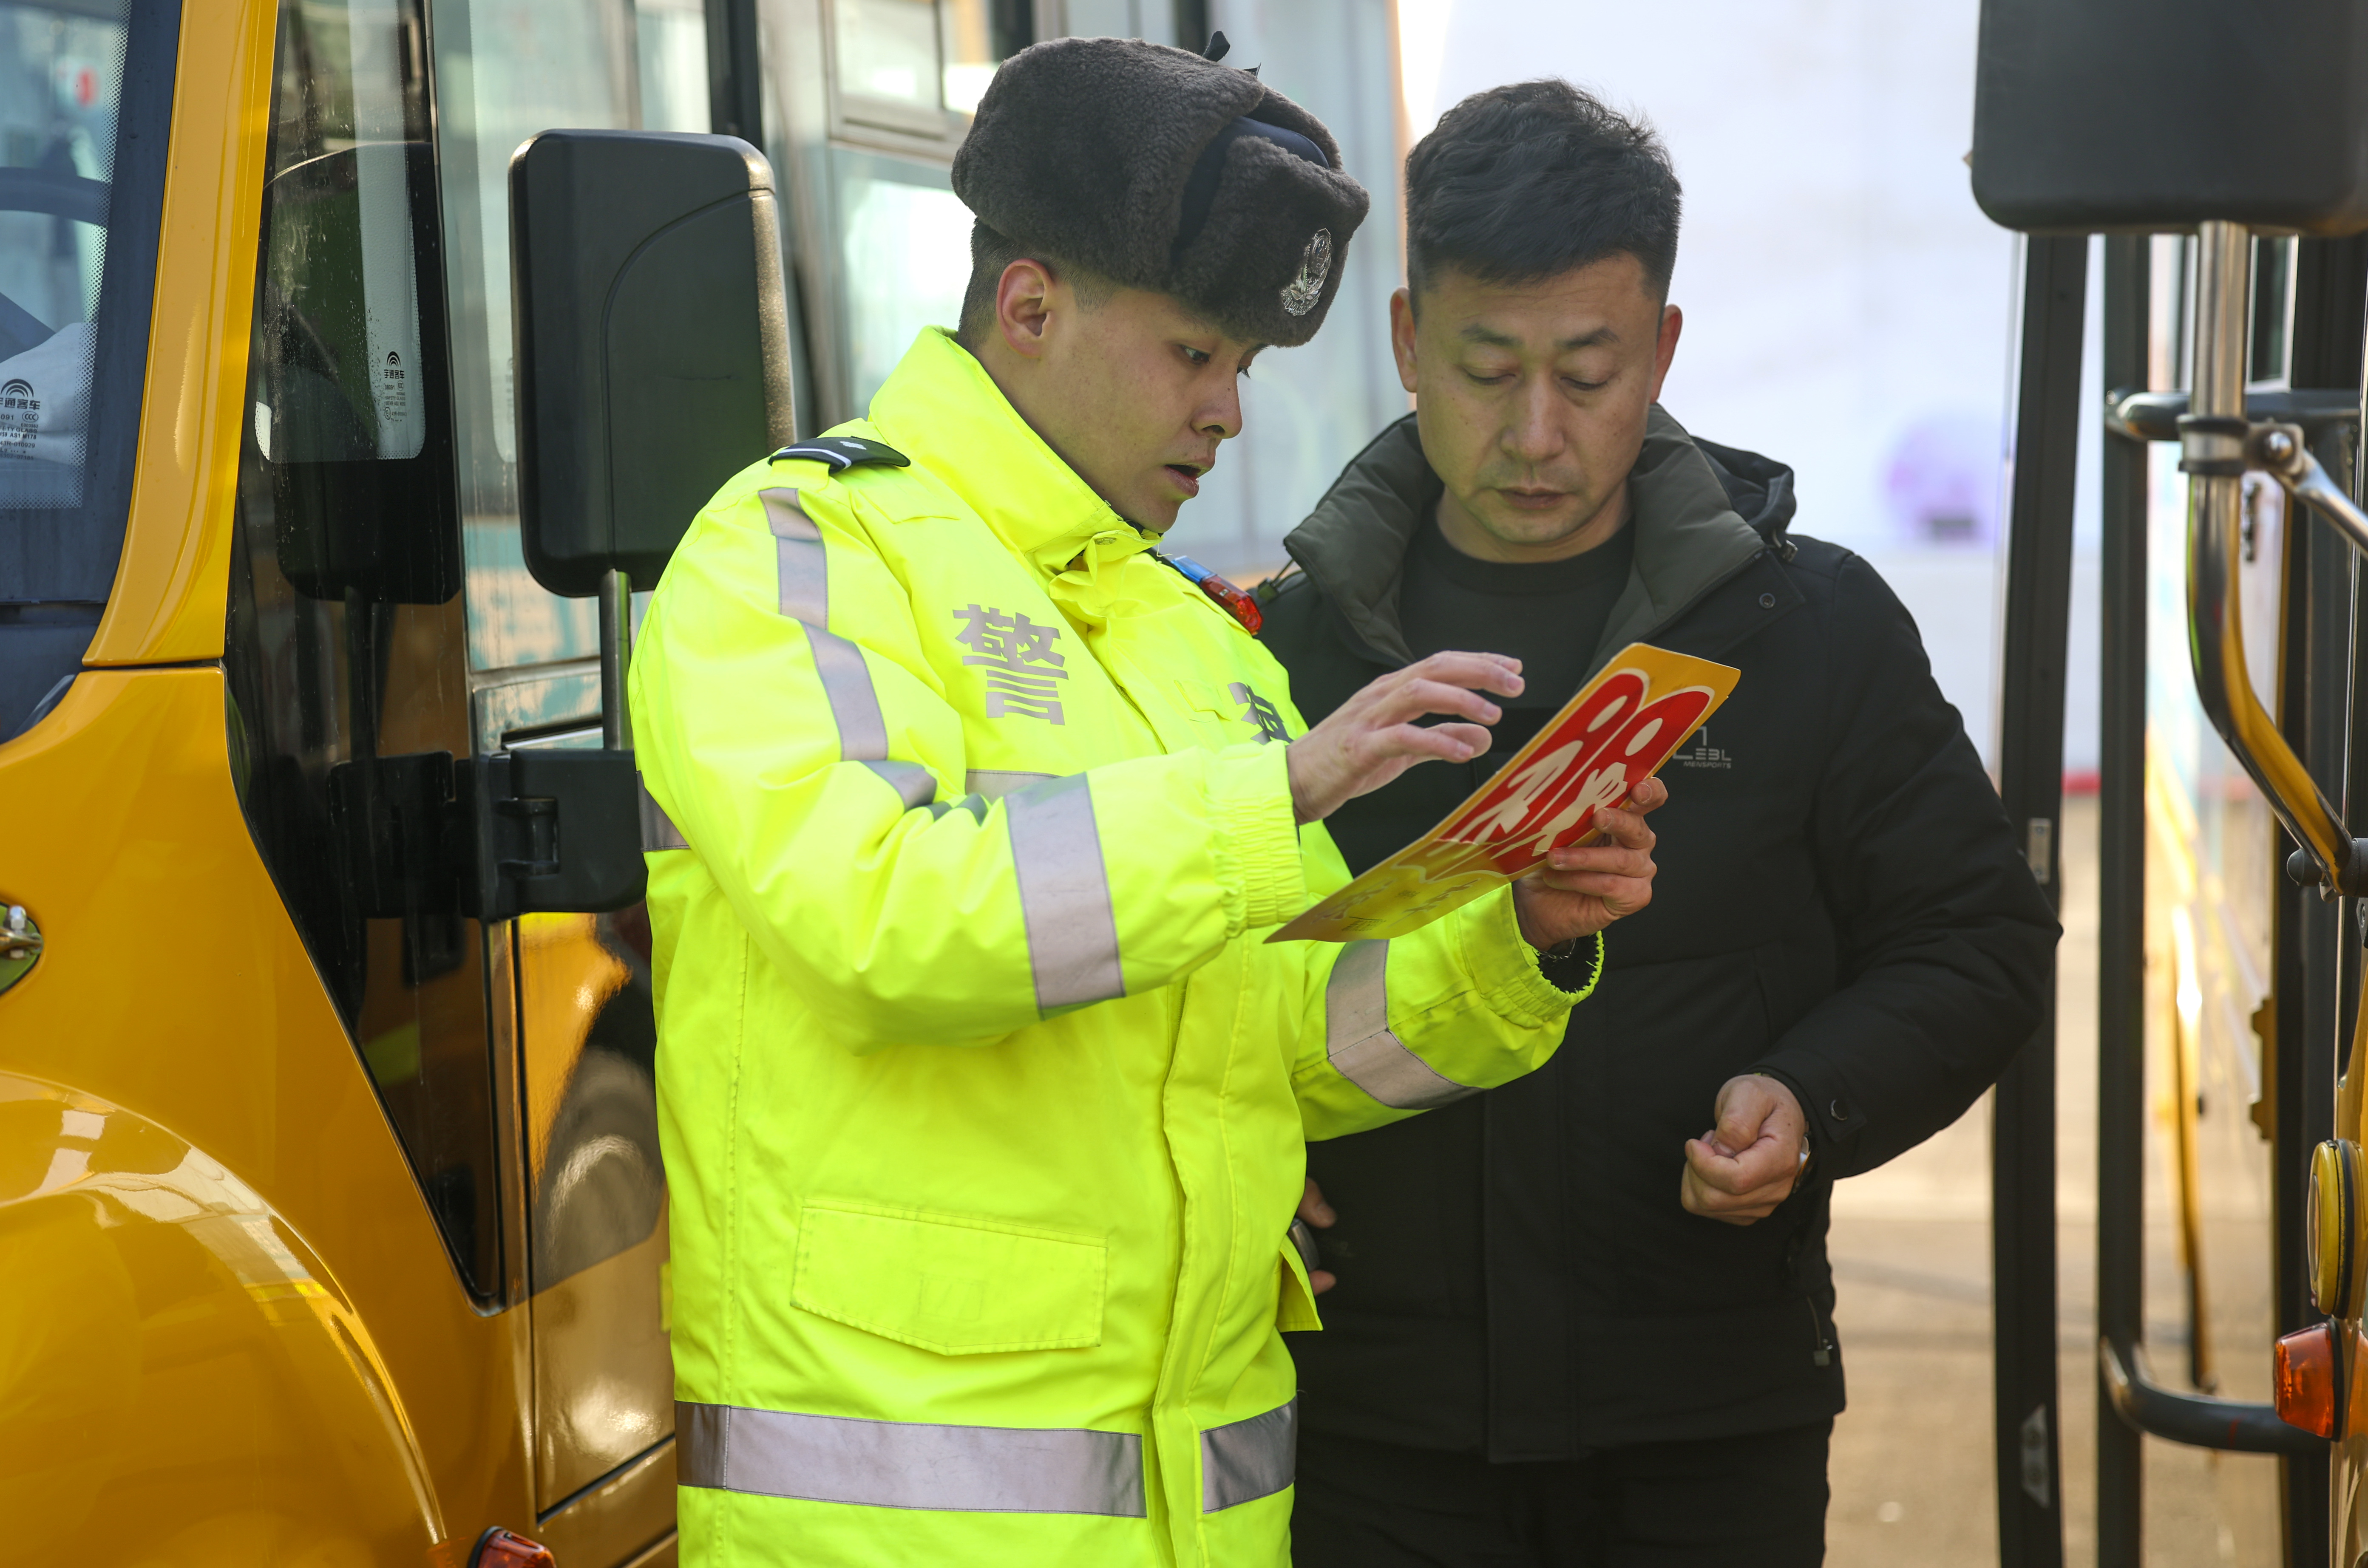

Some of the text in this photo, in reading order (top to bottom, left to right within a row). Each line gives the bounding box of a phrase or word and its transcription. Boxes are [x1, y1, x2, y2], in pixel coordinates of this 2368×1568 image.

[384, 369, 404, 379] 宇通客车
[0, 397, 40, 410] 通客车
[952, 604, 1069, 726] 警
